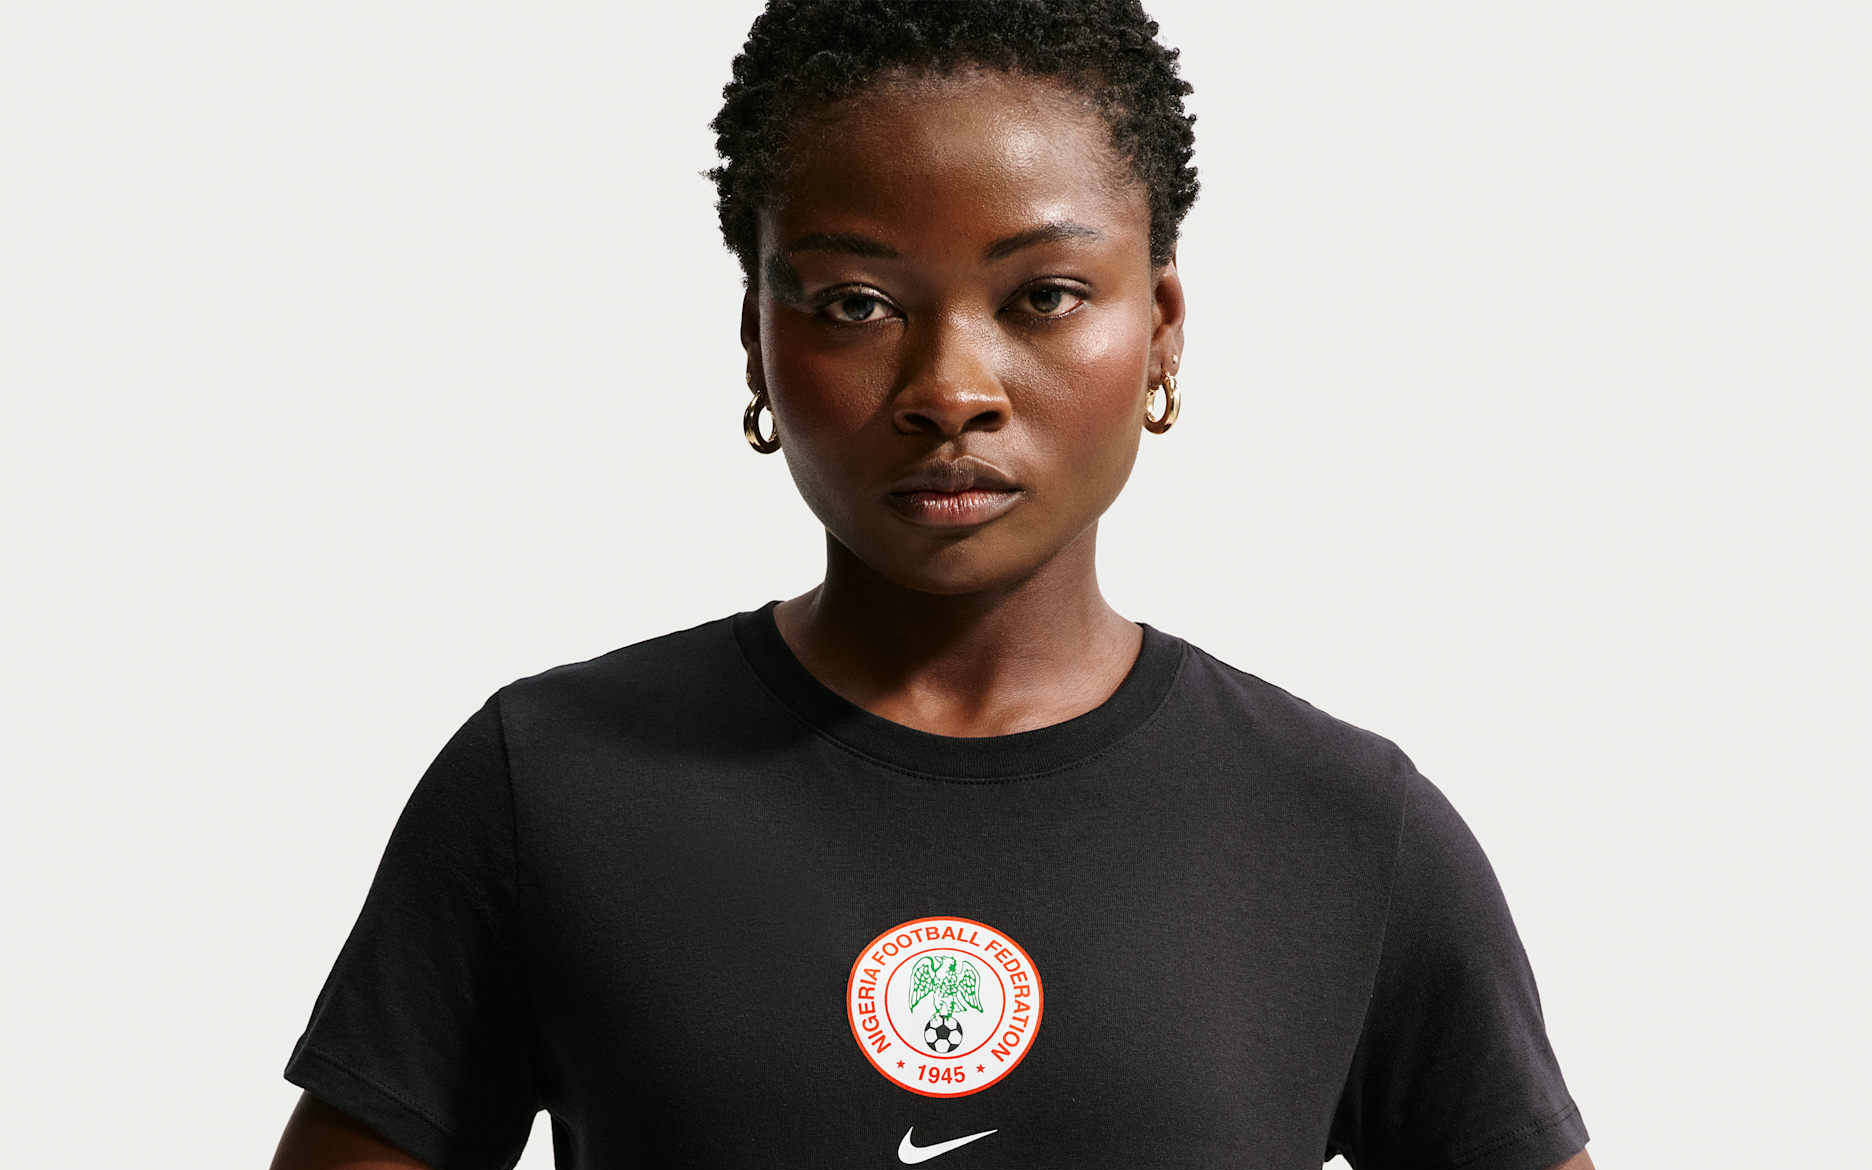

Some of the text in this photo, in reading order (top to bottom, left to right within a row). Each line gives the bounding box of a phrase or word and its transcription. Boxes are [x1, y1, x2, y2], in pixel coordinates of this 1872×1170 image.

[858, 926, 1031, 1063] NIGERIA FOOTBALL FEDERATION
[917, 1064, 966, 1084] 1945
